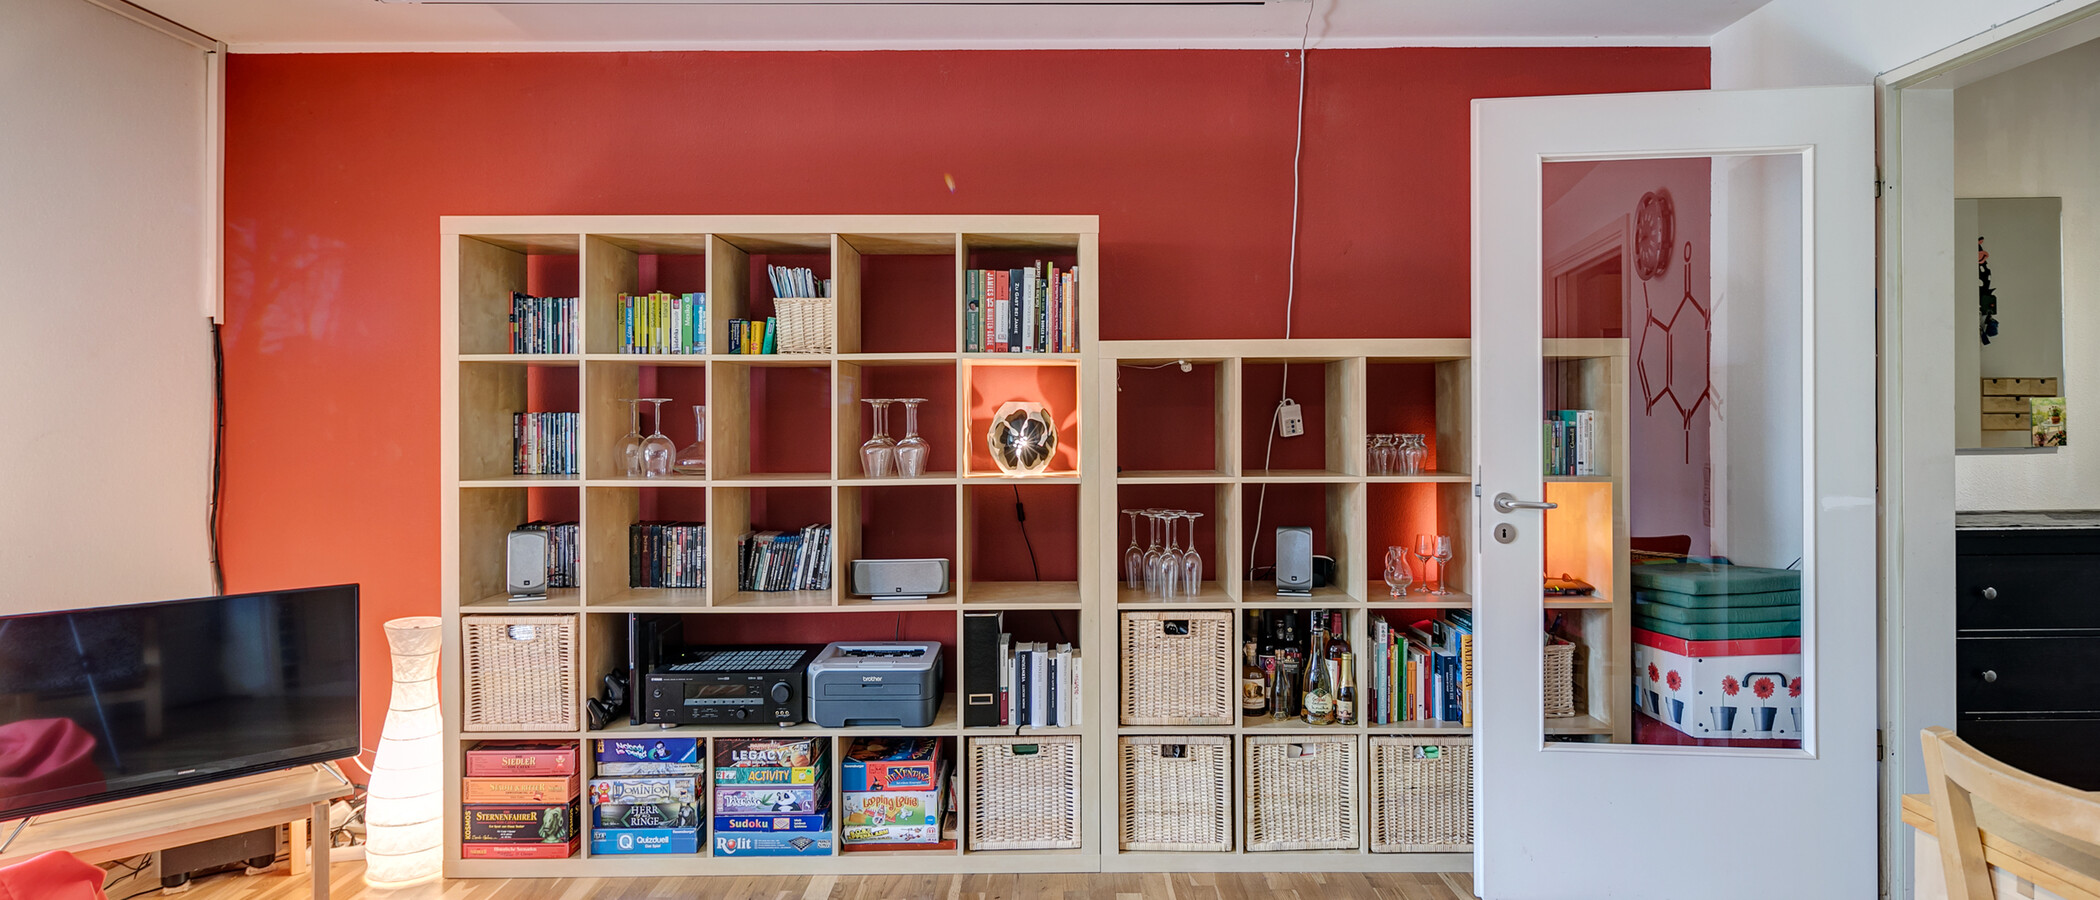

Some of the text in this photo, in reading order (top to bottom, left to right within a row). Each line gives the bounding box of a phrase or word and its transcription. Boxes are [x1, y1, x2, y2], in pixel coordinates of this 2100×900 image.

[1014, 282, 1020, 291] ZU
[732, 750, 784, 761] LEGACY
[501, 756, 536, 766] SIEDLER
[748, 769, 790, 781] ACTIVITY
[613, 782, 669, 797] DOMINION
[863, 796, 919, 811] Looping Louie
[631, 805, 659, 814] HERR
[476, 812, 537, 822] STERNENFAHRER
[631, 818, 659, 826] RINGE
[729, 819, 768, 829] Sudoku
[619, 834, 634, 850] Q
[636, 836, 669, 844] Quizduell
[716, 837, 752, 855] Rolit
